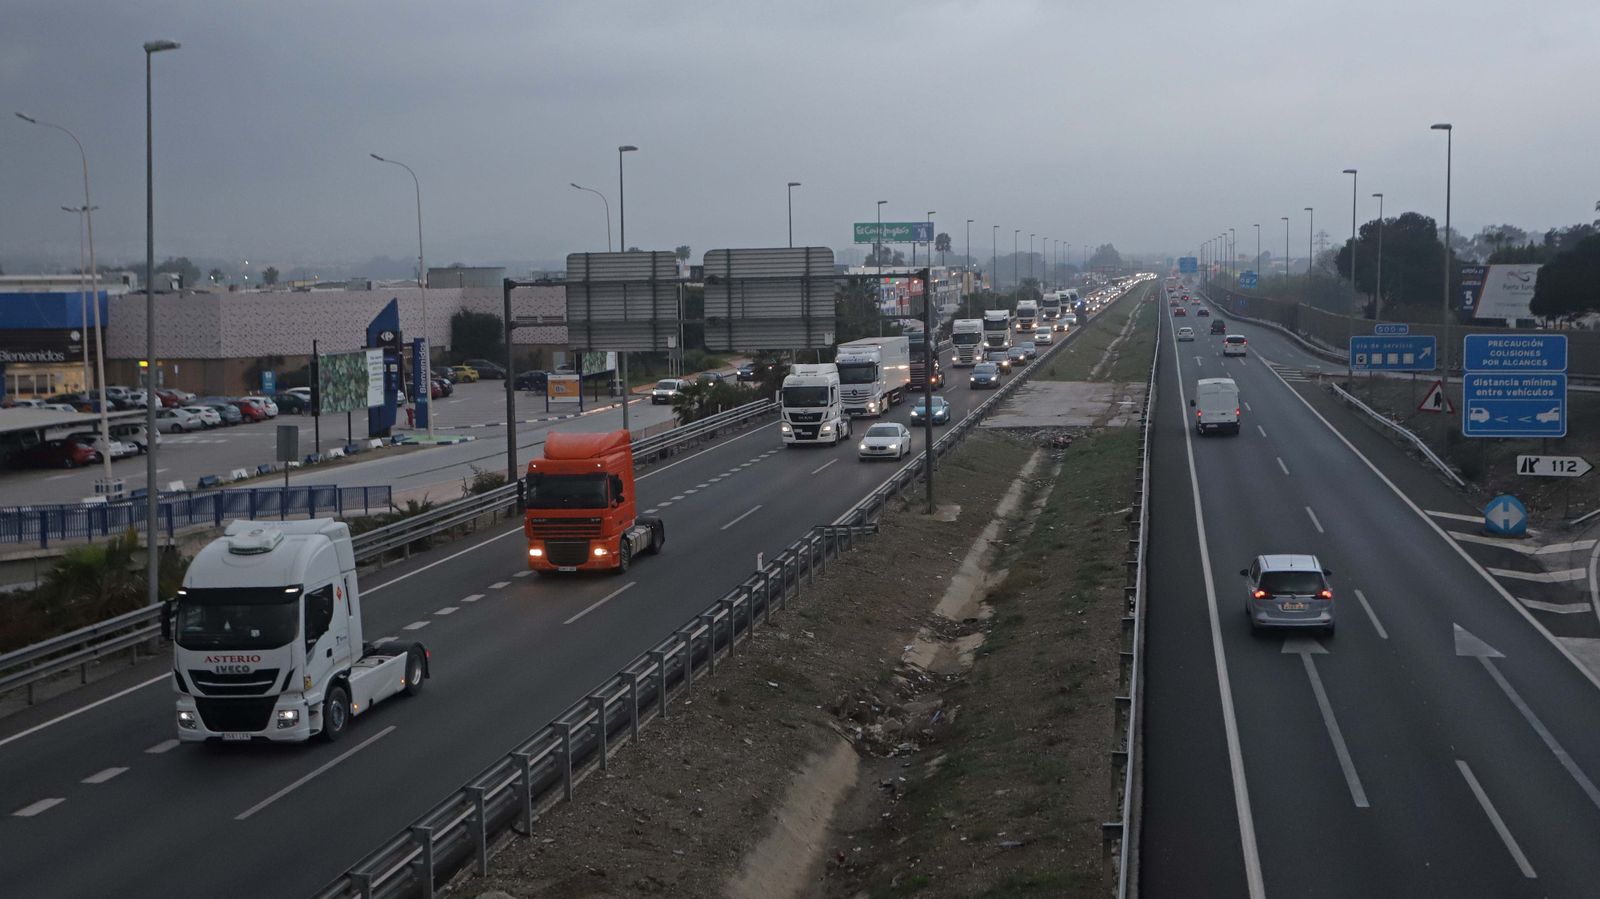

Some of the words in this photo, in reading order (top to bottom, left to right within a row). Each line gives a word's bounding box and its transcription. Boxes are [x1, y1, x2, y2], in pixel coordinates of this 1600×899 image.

[1488, 339, 1544, 347] PRECAUCIÓN
[1473, 378, 1519, 386] distancia
[1522, 378, 1557, 386] mínima
[1506, 388, 1554, 396] vehículos
[1552, 460, 1577, 472] 112
[204, 655, 261, 664] ASTERIO
[215, 665, 250, 673] IVECO
